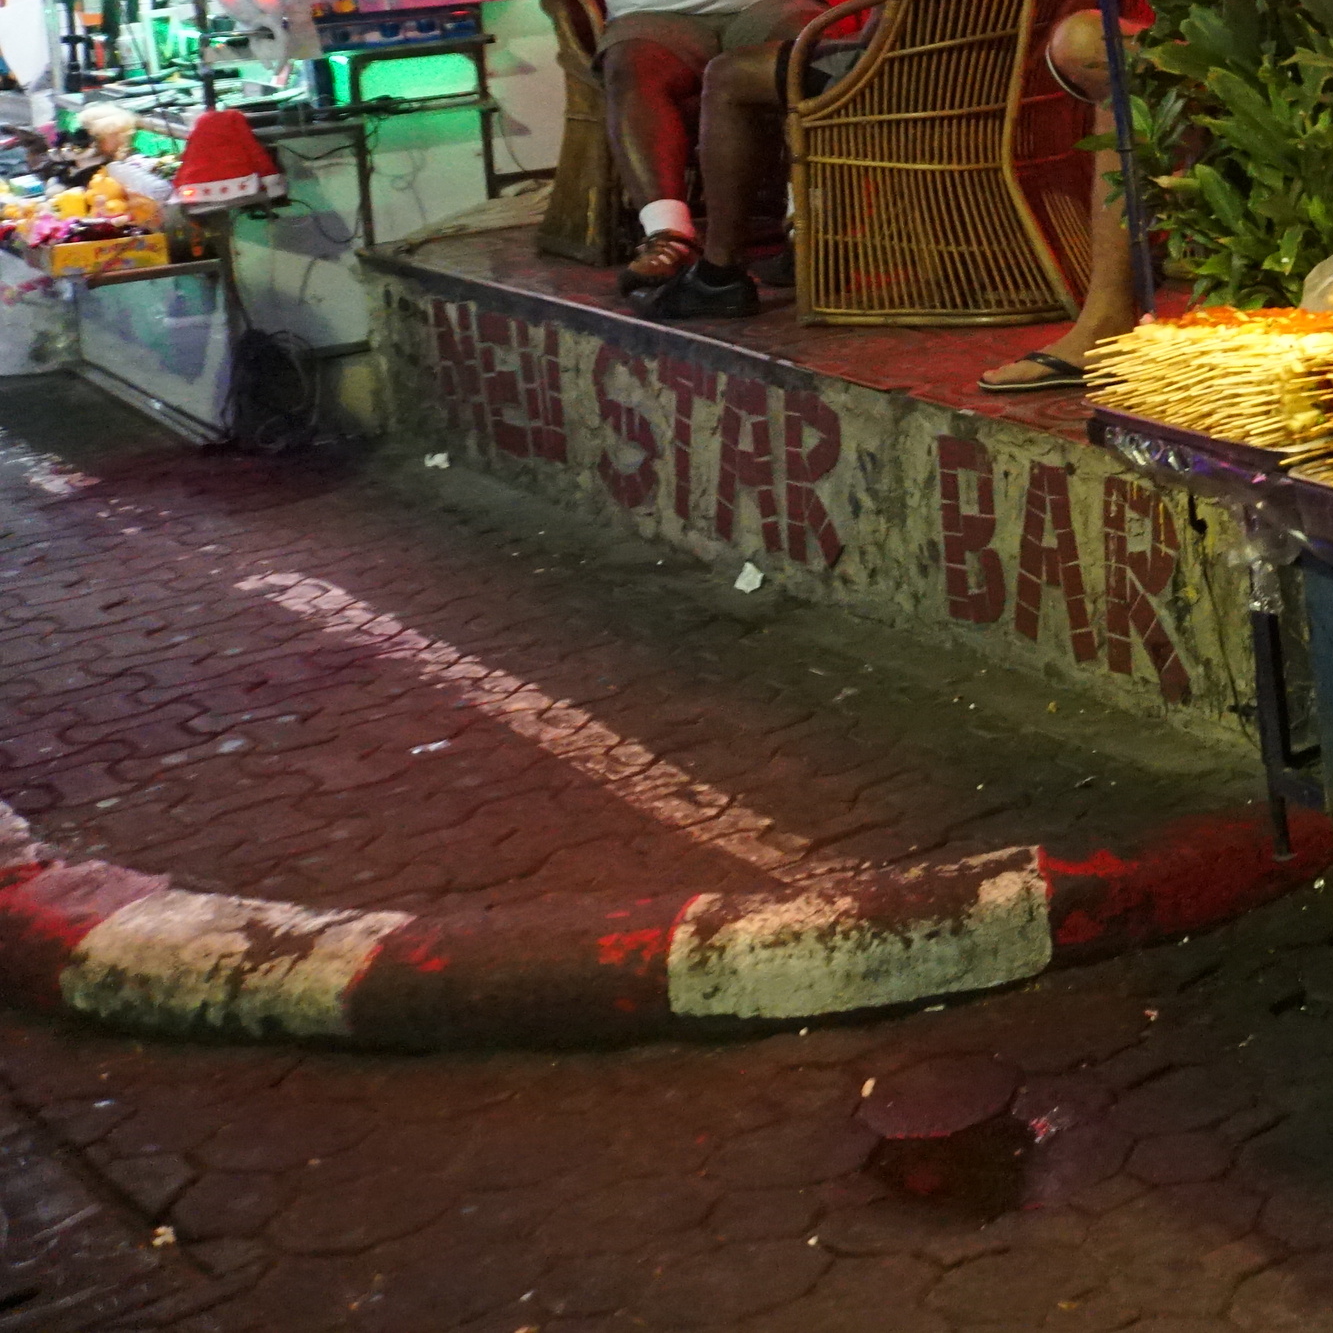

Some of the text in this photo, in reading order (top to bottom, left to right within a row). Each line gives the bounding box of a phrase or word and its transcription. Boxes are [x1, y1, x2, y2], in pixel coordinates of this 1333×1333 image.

[429, 296, 1193, 704] NEW STAR BAR
